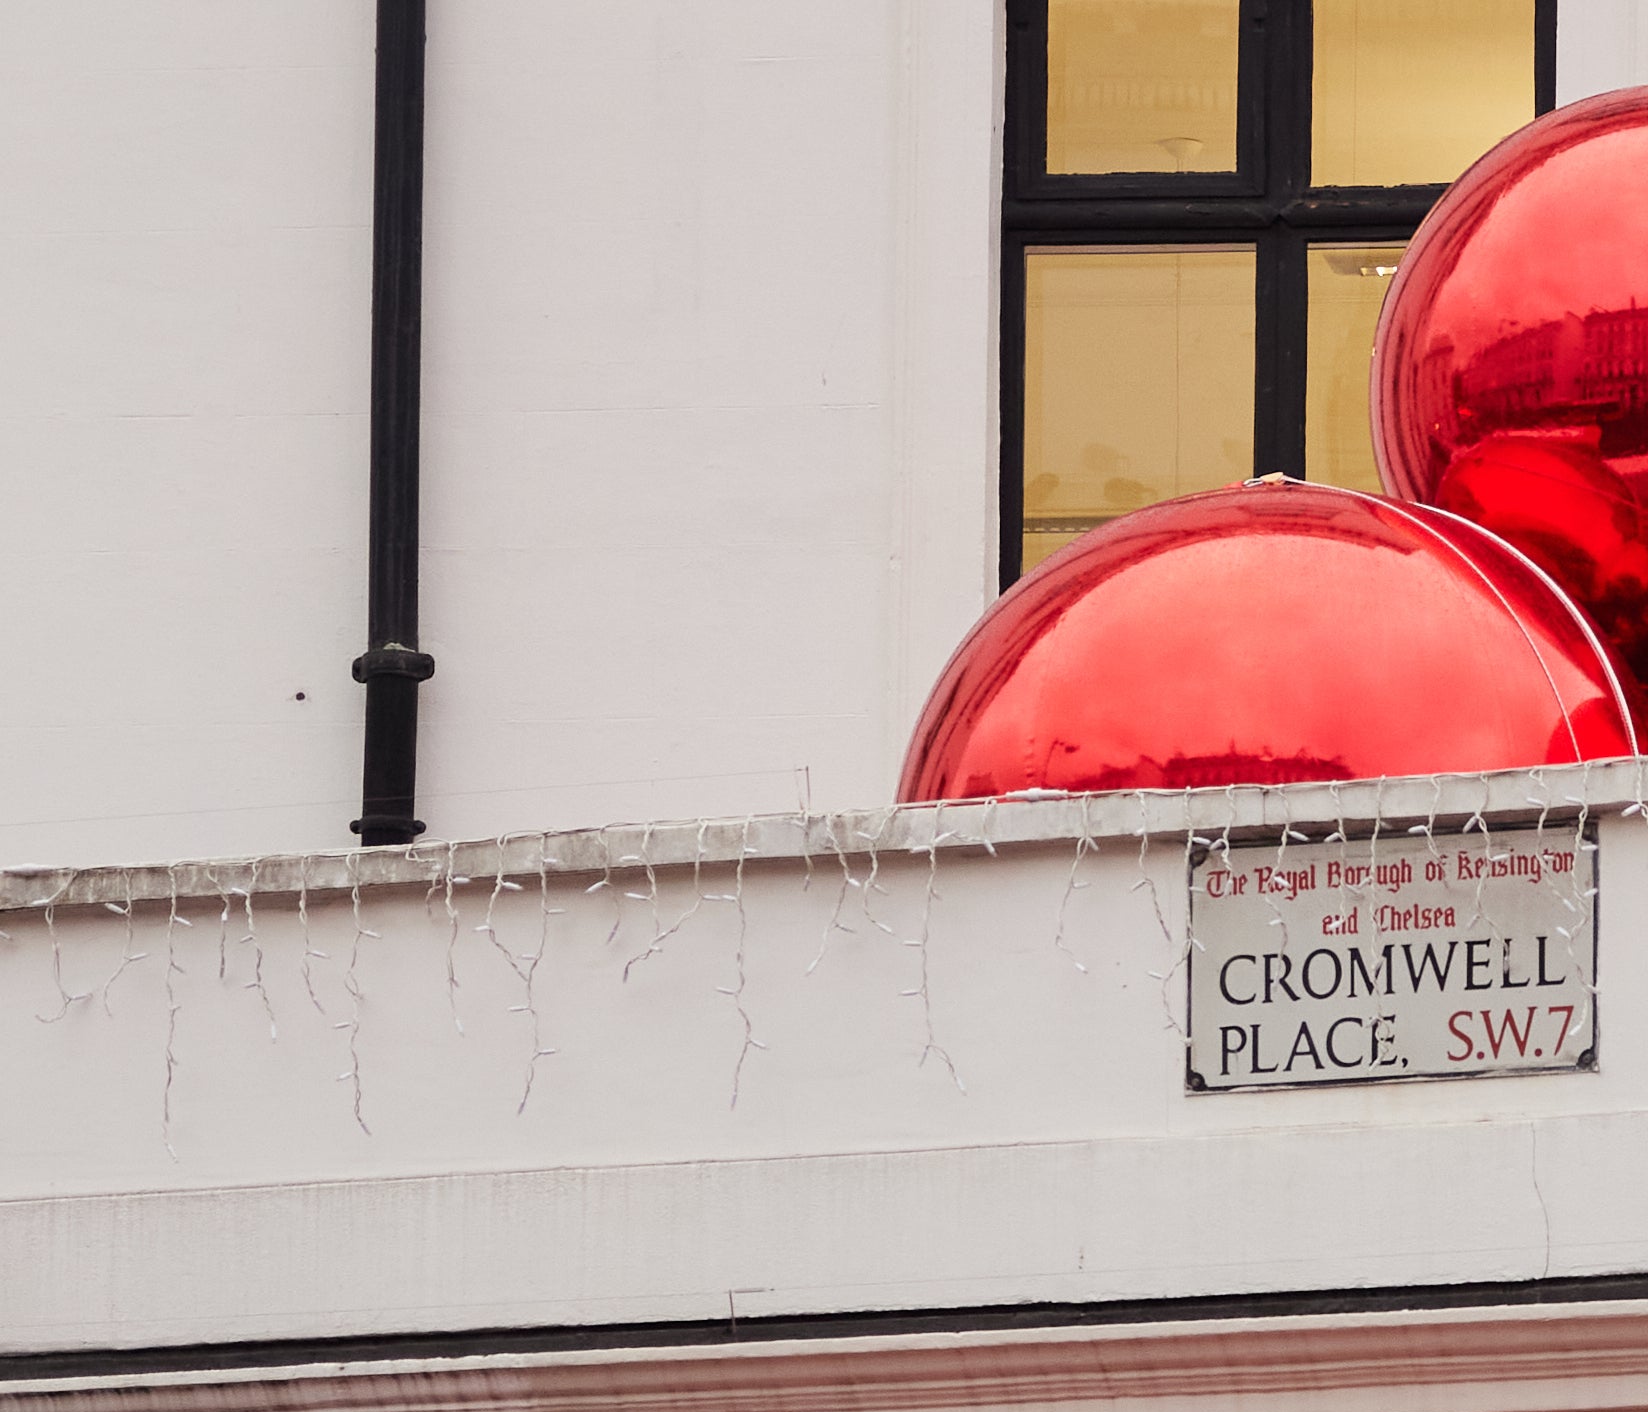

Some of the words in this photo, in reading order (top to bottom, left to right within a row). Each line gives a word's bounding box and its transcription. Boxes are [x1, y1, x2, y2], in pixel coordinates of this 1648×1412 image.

[1207, 869, 1245, 898] The
[1254, 864, 1316, 902] Royal
[1425, 854, 1449, 882] of
[1219, 936, 1566, 1005] CROMWELL
[1219, 1014, 1409, 1076] PLACE,
[1446, 1005, 1575, 1062] S.W.7
